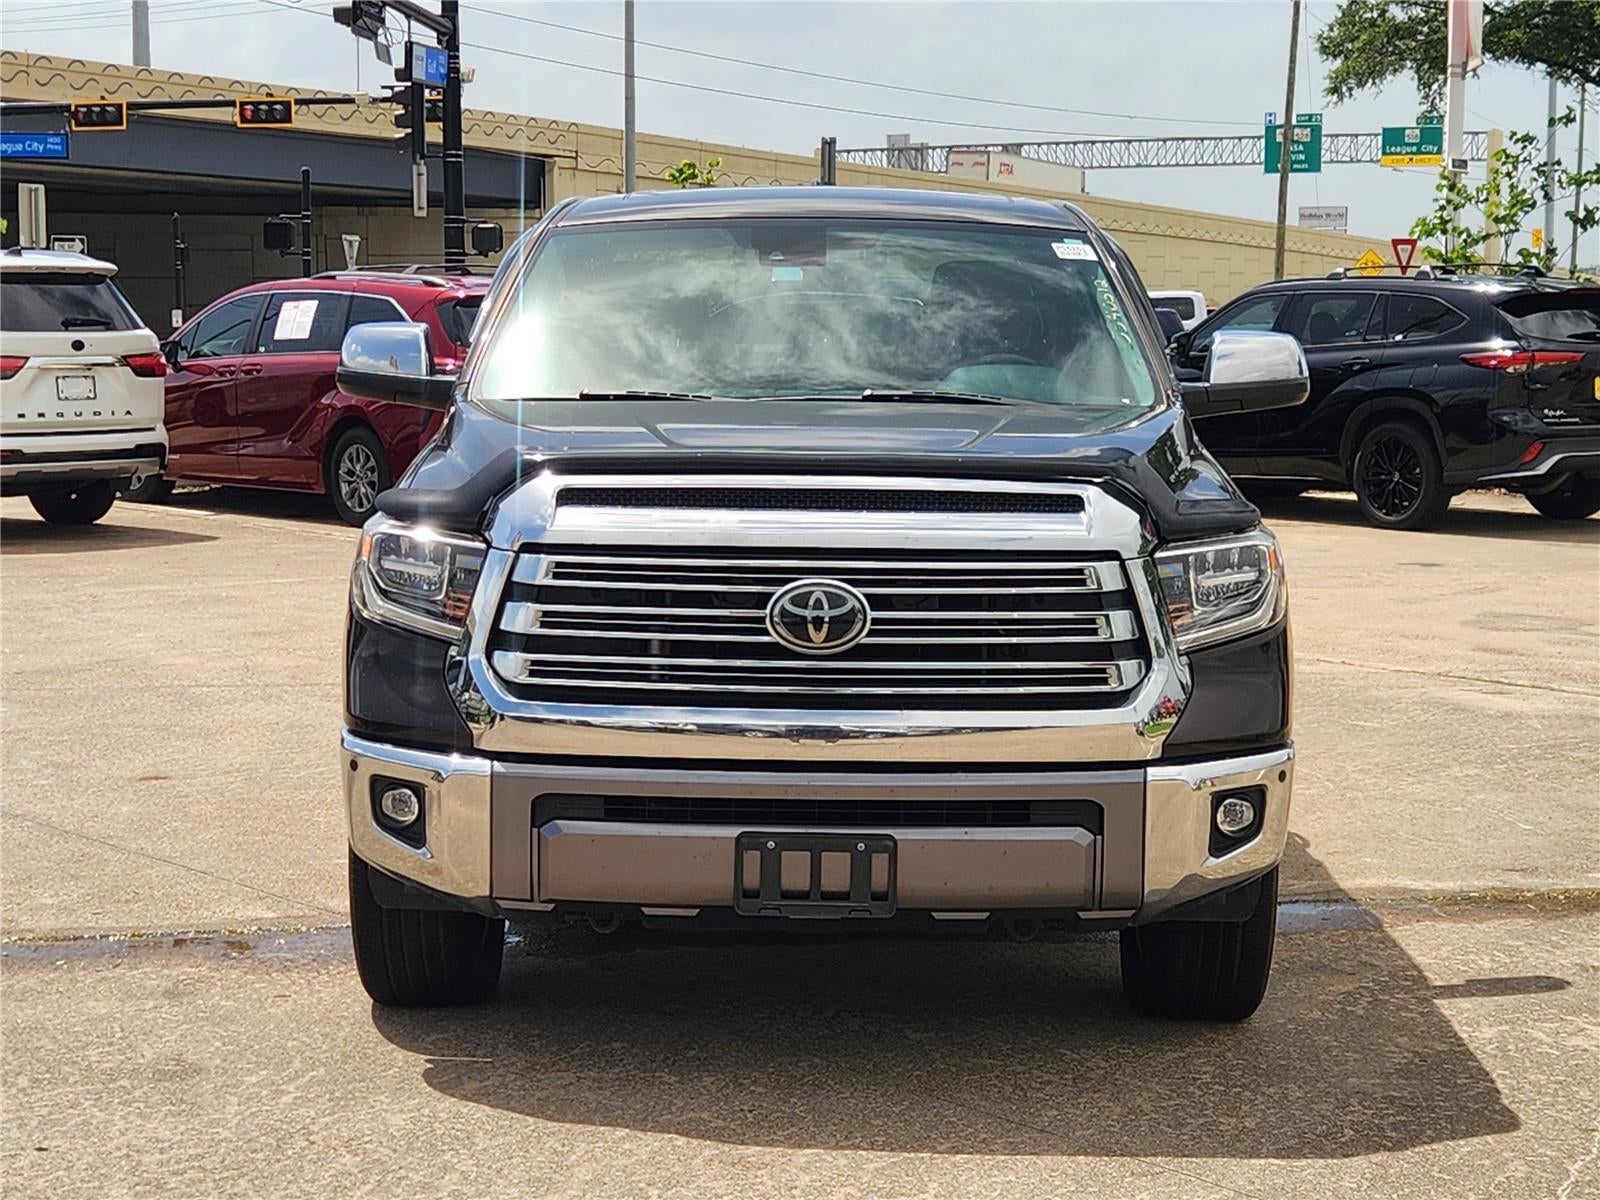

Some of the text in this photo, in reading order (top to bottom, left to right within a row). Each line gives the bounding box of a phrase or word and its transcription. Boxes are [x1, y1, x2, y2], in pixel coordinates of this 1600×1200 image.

[25, 141, 45, 153] City
[1385, 145, 1439, 154] League City
[17, 410, 133, 419] SEQUOIA
